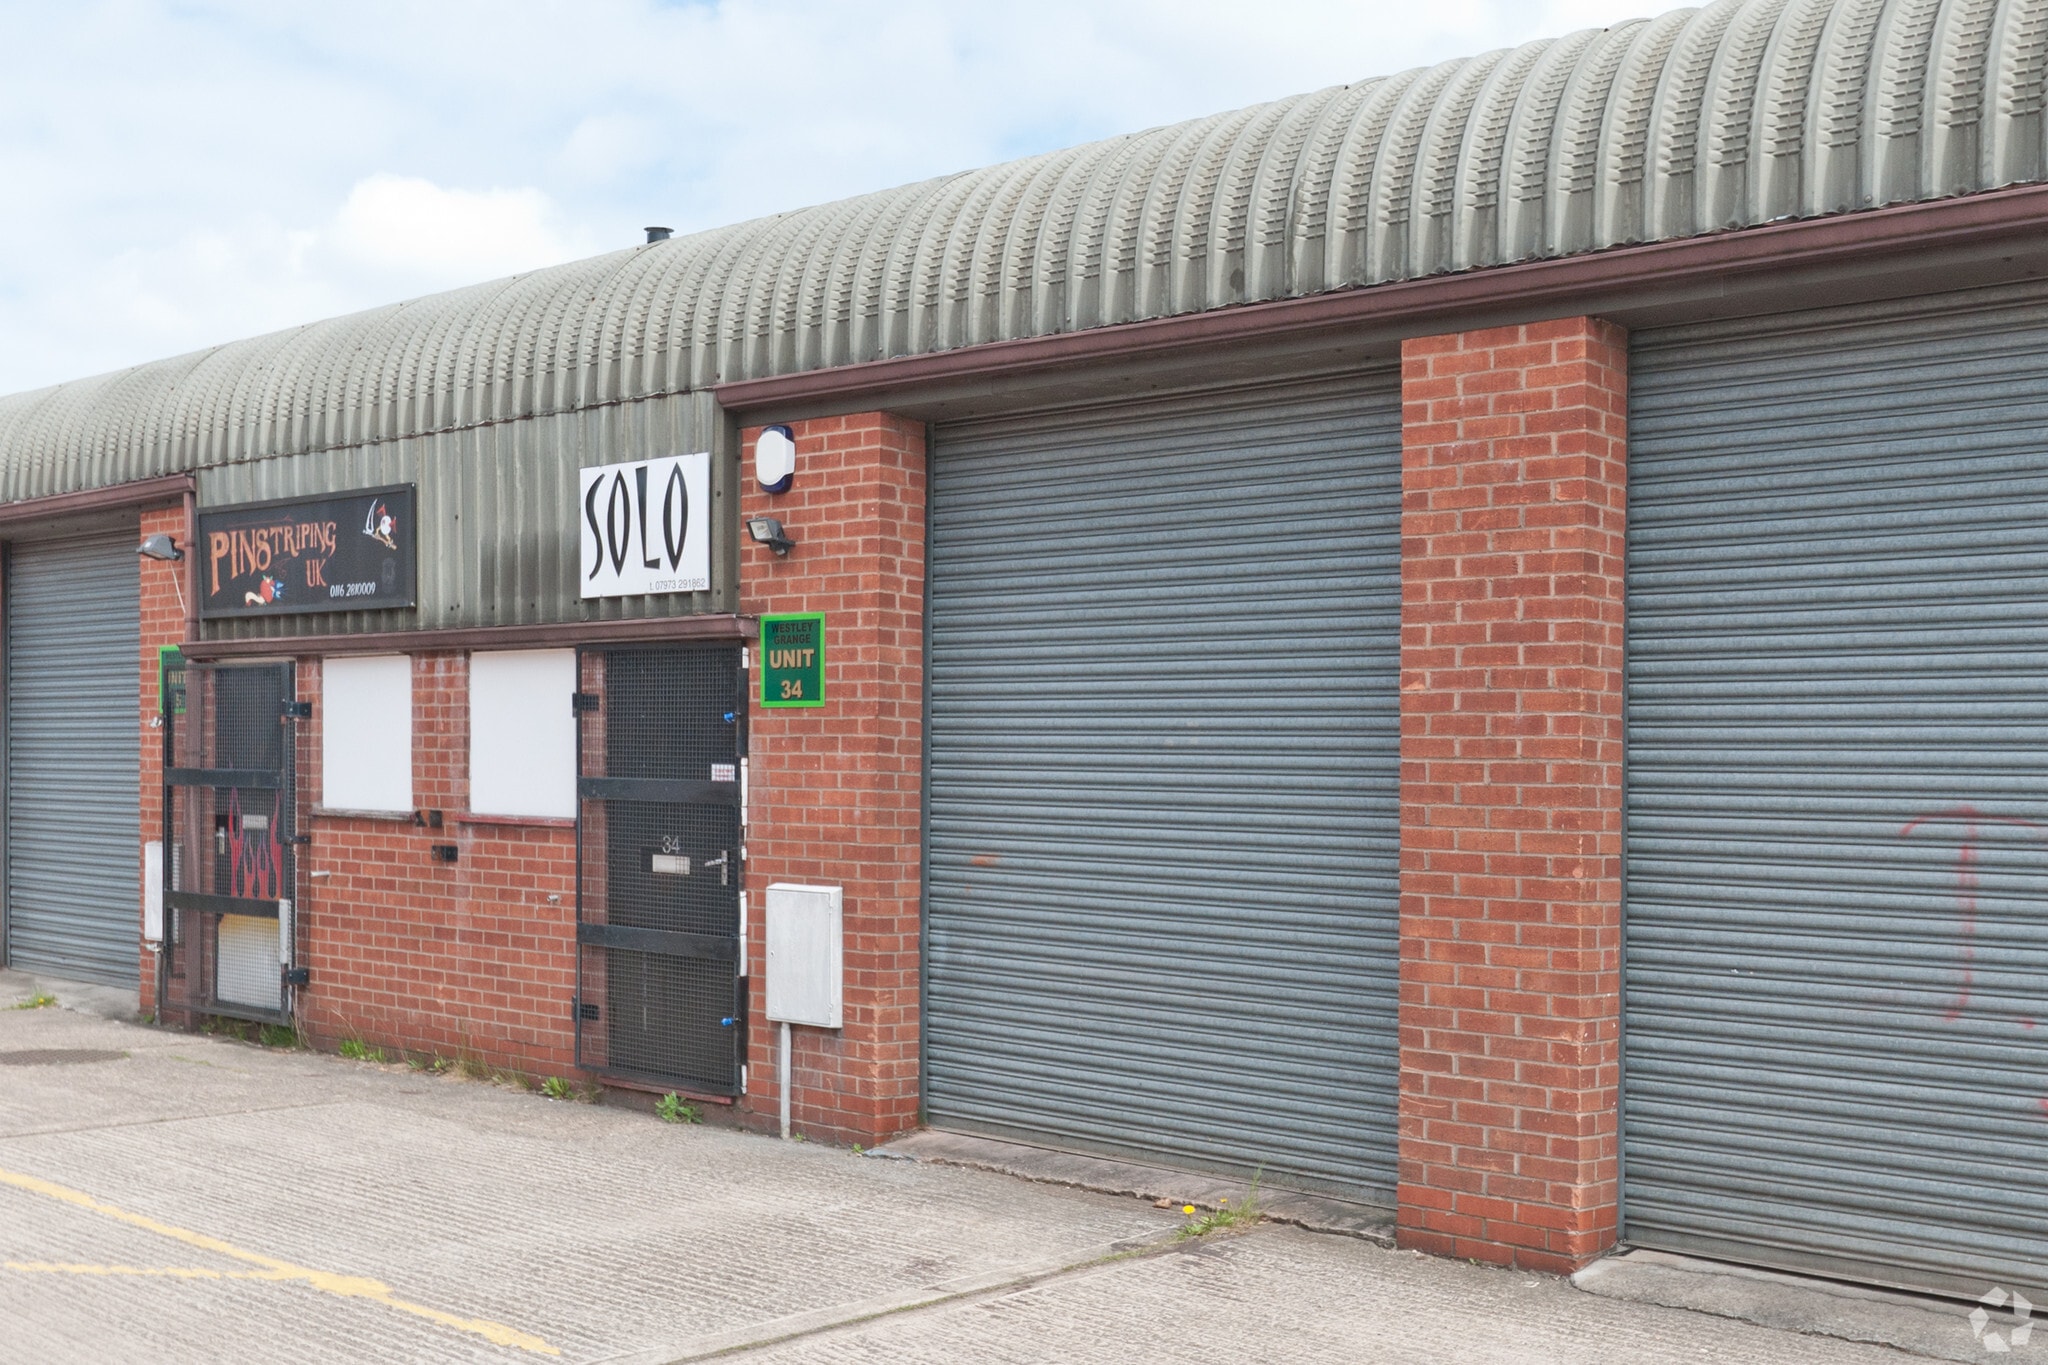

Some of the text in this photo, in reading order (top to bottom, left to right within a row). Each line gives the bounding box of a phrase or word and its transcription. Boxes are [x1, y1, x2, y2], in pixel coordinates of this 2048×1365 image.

[585, 462, 688, 581] SOLO
[208, 521, 337, 597] PINSTRIPING
[306, 558, 327, 587] UK
[330, 584, 344, 598] 0116
[655, 580, 677, 590] 07973
[771, 622, 813, 633] WESTLEY
[774, 634, 811, 645] GRANGE
[769, 648, 815, 669] UNIT
[781, 680, 803, 699] 34
[662, 835, 680, 854] 34
